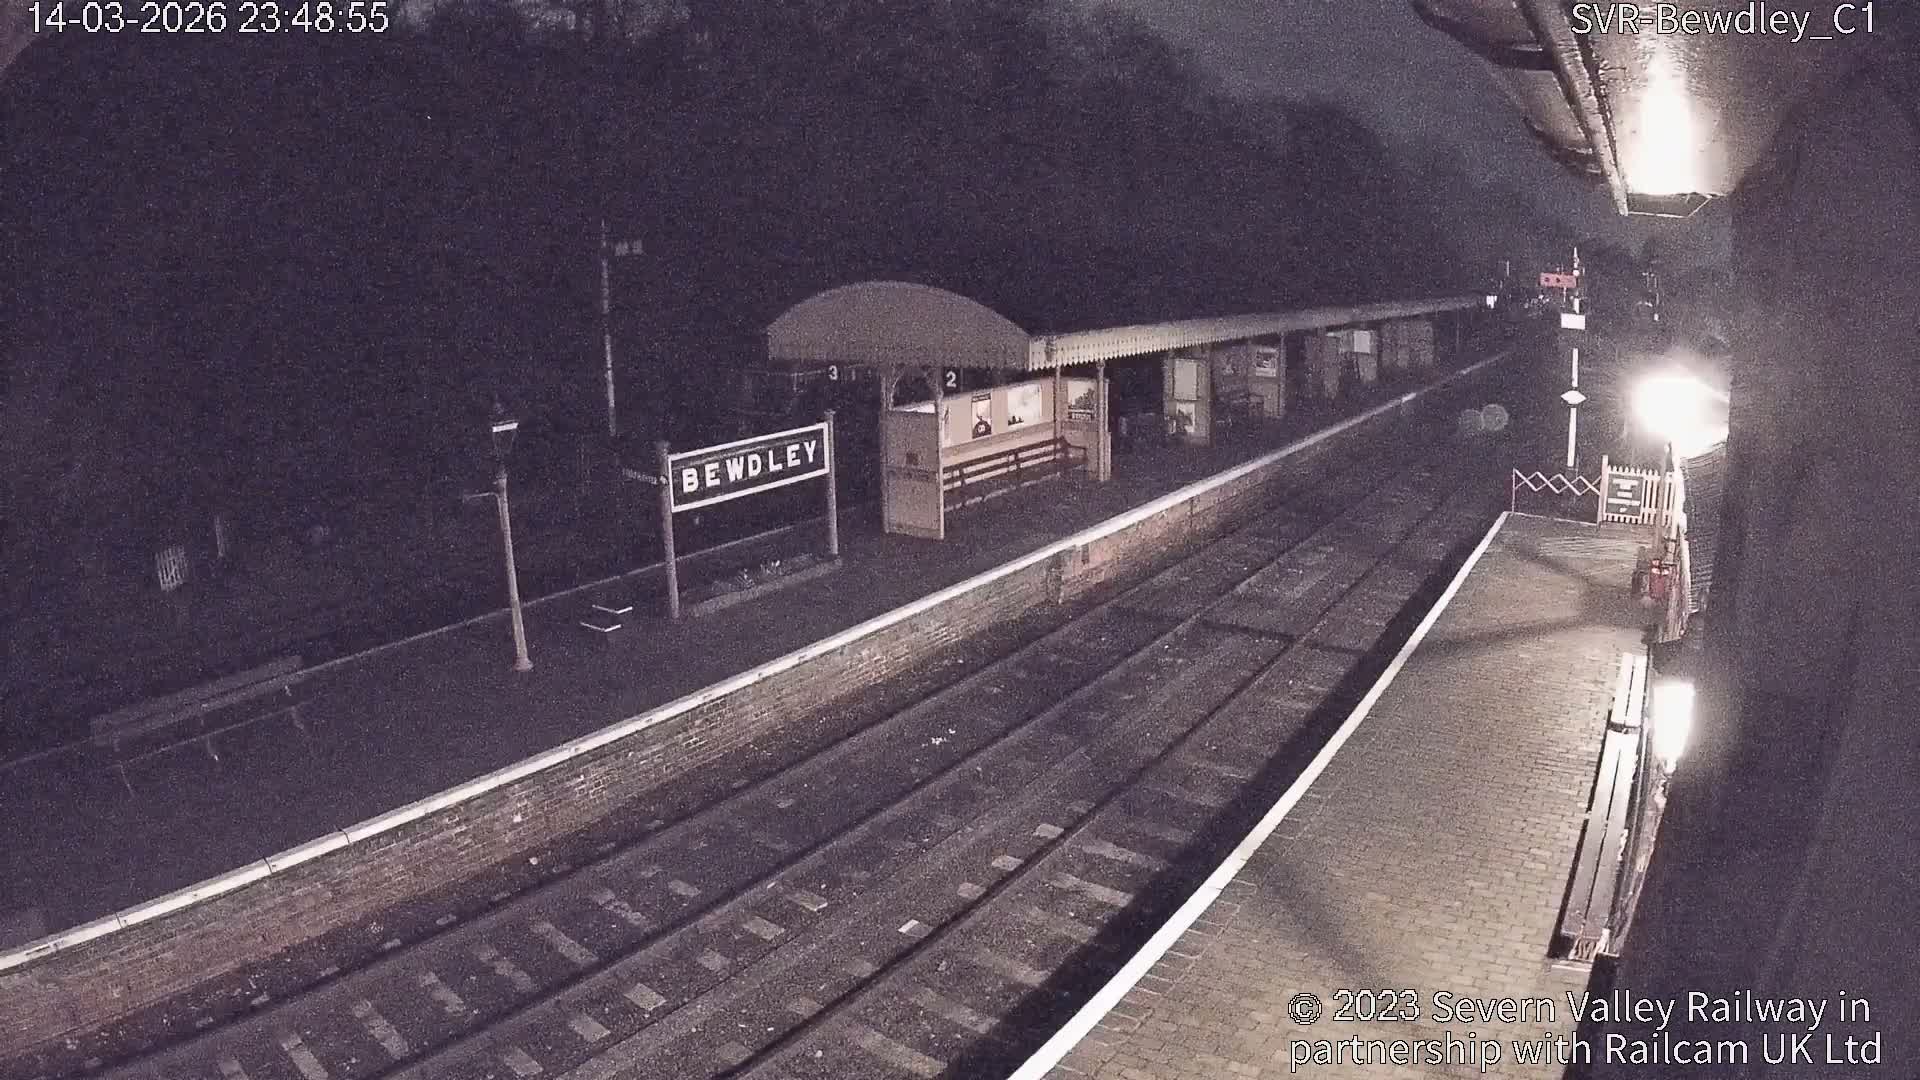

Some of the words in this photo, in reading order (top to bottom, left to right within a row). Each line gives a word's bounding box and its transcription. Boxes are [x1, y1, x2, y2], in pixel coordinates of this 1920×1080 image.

[828, 365, 839, 381] 3
[945, 370, 957, 388] 2
[681, 439, 817, 494] BEWDLEY
